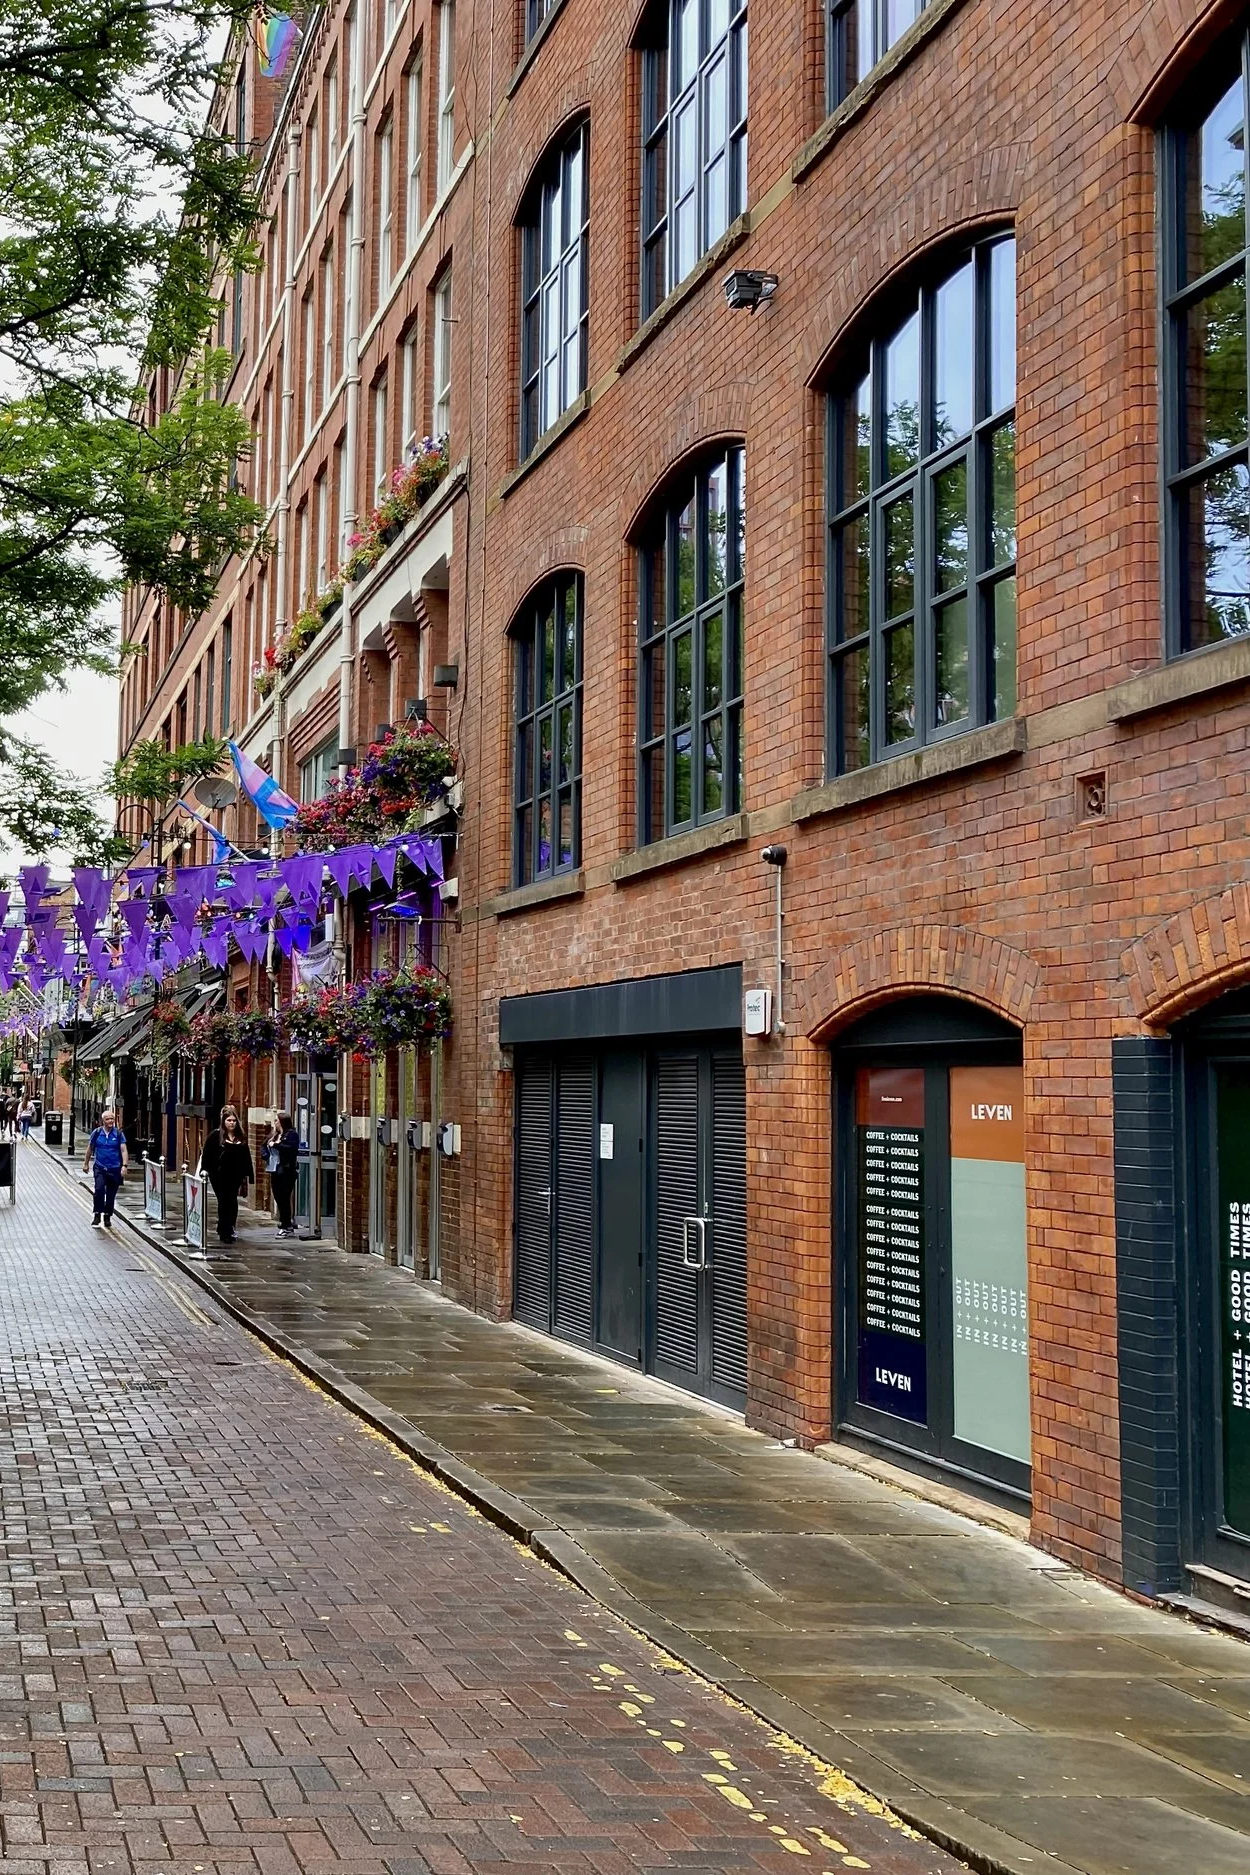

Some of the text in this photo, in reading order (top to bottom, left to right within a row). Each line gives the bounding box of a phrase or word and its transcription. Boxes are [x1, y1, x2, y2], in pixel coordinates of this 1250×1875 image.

[971, 1104, 1012, 1121] LEVEN
[891, 1133, 918, 1142] COCKTAILS
[866, 1145, 885, 1153] COFFEE
[891, 1147, 919, 1157] COCKTAILS
[866, 1159, 885, 1168] COFFEE
[891, 1162, 919, 1171] COCKTAILS
[866, 1173, 885, 1182] COFFEE
[891, 1176, 919, 1186] COCKTAILS
[866, 1187, 885, 1196] COFFEE
[891, 1190, 919, 1200] COCKTAILS
[866, 1205, 885, 1214] COFFEE
[891, 1208, 919, 1219] COCKTAILS
[866, 1219, 885, 1228] COFFEE
[891, 1223, 919, 1234] COCKTAILS
[1242, 1203, 1250, 1260] TIMES
[866, 1233, 885, 1243] COFFEE
[891, 1237, 919, 1248] COCKTAILS
[866, 1247, 885, 1257] COFFEE
[891, 1251, 920, 1263] COCKTAILS
[866, 1261, 885, 1271] COFFEE
[891, 1266, 920, 1278] COCKTAILS
[867, 1275, 885, 1285] COFFEE
[891, 1280, 920, 1293] COCKTAILS
[867, 1289, 885, 1300] COFFEE
[891, 1295, 920, 1307] COCKTAILS
[1230, 1202, 1243, 1408] HOTEL + GOOD TIMES
[867, 1303, 885, 1314] COFFEE
[892, 1309, 920, 1322] COCKTAILS
[867, 1317, 885, 1328] COFFEE
[892, 1323, 920, 1337] COCKTAILS
[956, 1324, 962, 1338] IN
[965, 1327, 971, 1340] IN
[974, 1329, 980, 1343] IN
[983, 1331, 989, 1345] IN
[992, 1334, 998, 1348] IN
[1002, 1336, 1008, 1350] IN
[1011, 1338, 1017, 1352] IN
[1020, 1341, 1027, 1355] IN
[876, 1367, 911, 1392] LEVEN
